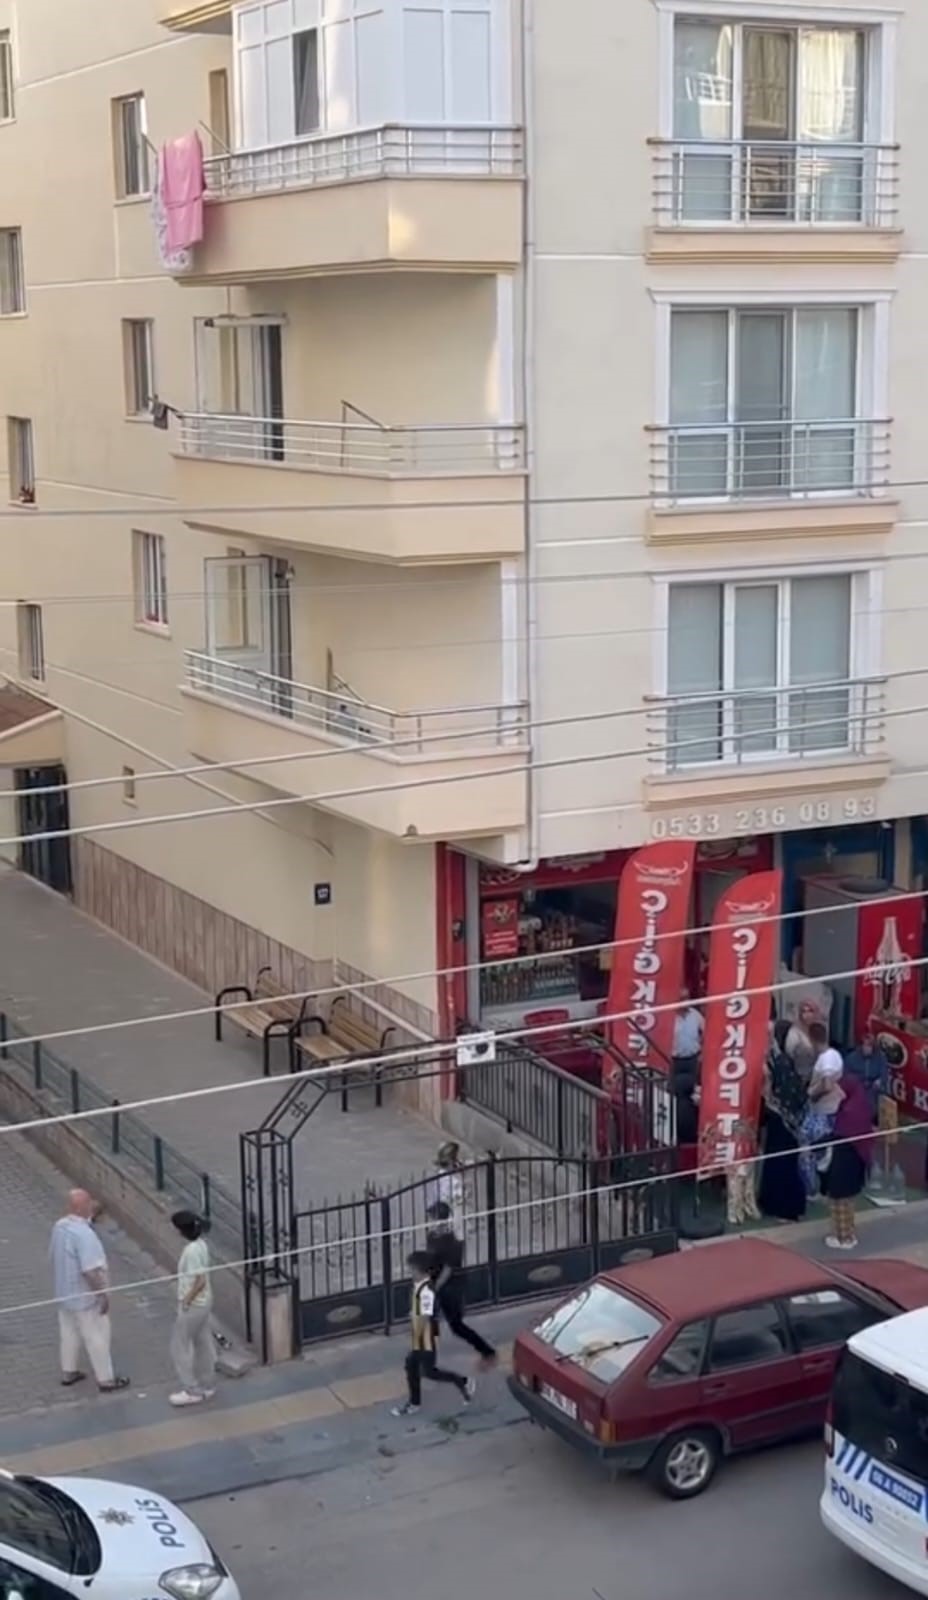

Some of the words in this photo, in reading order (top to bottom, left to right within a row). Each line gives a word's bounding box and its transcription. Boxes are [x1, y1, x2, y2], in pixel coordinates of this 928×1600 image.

[652, 813, 720, 838] 0533
[736, 807, 785, 831] 236
[801, 802, 829, 822] 08
[844, 797, 875, 818] 93
